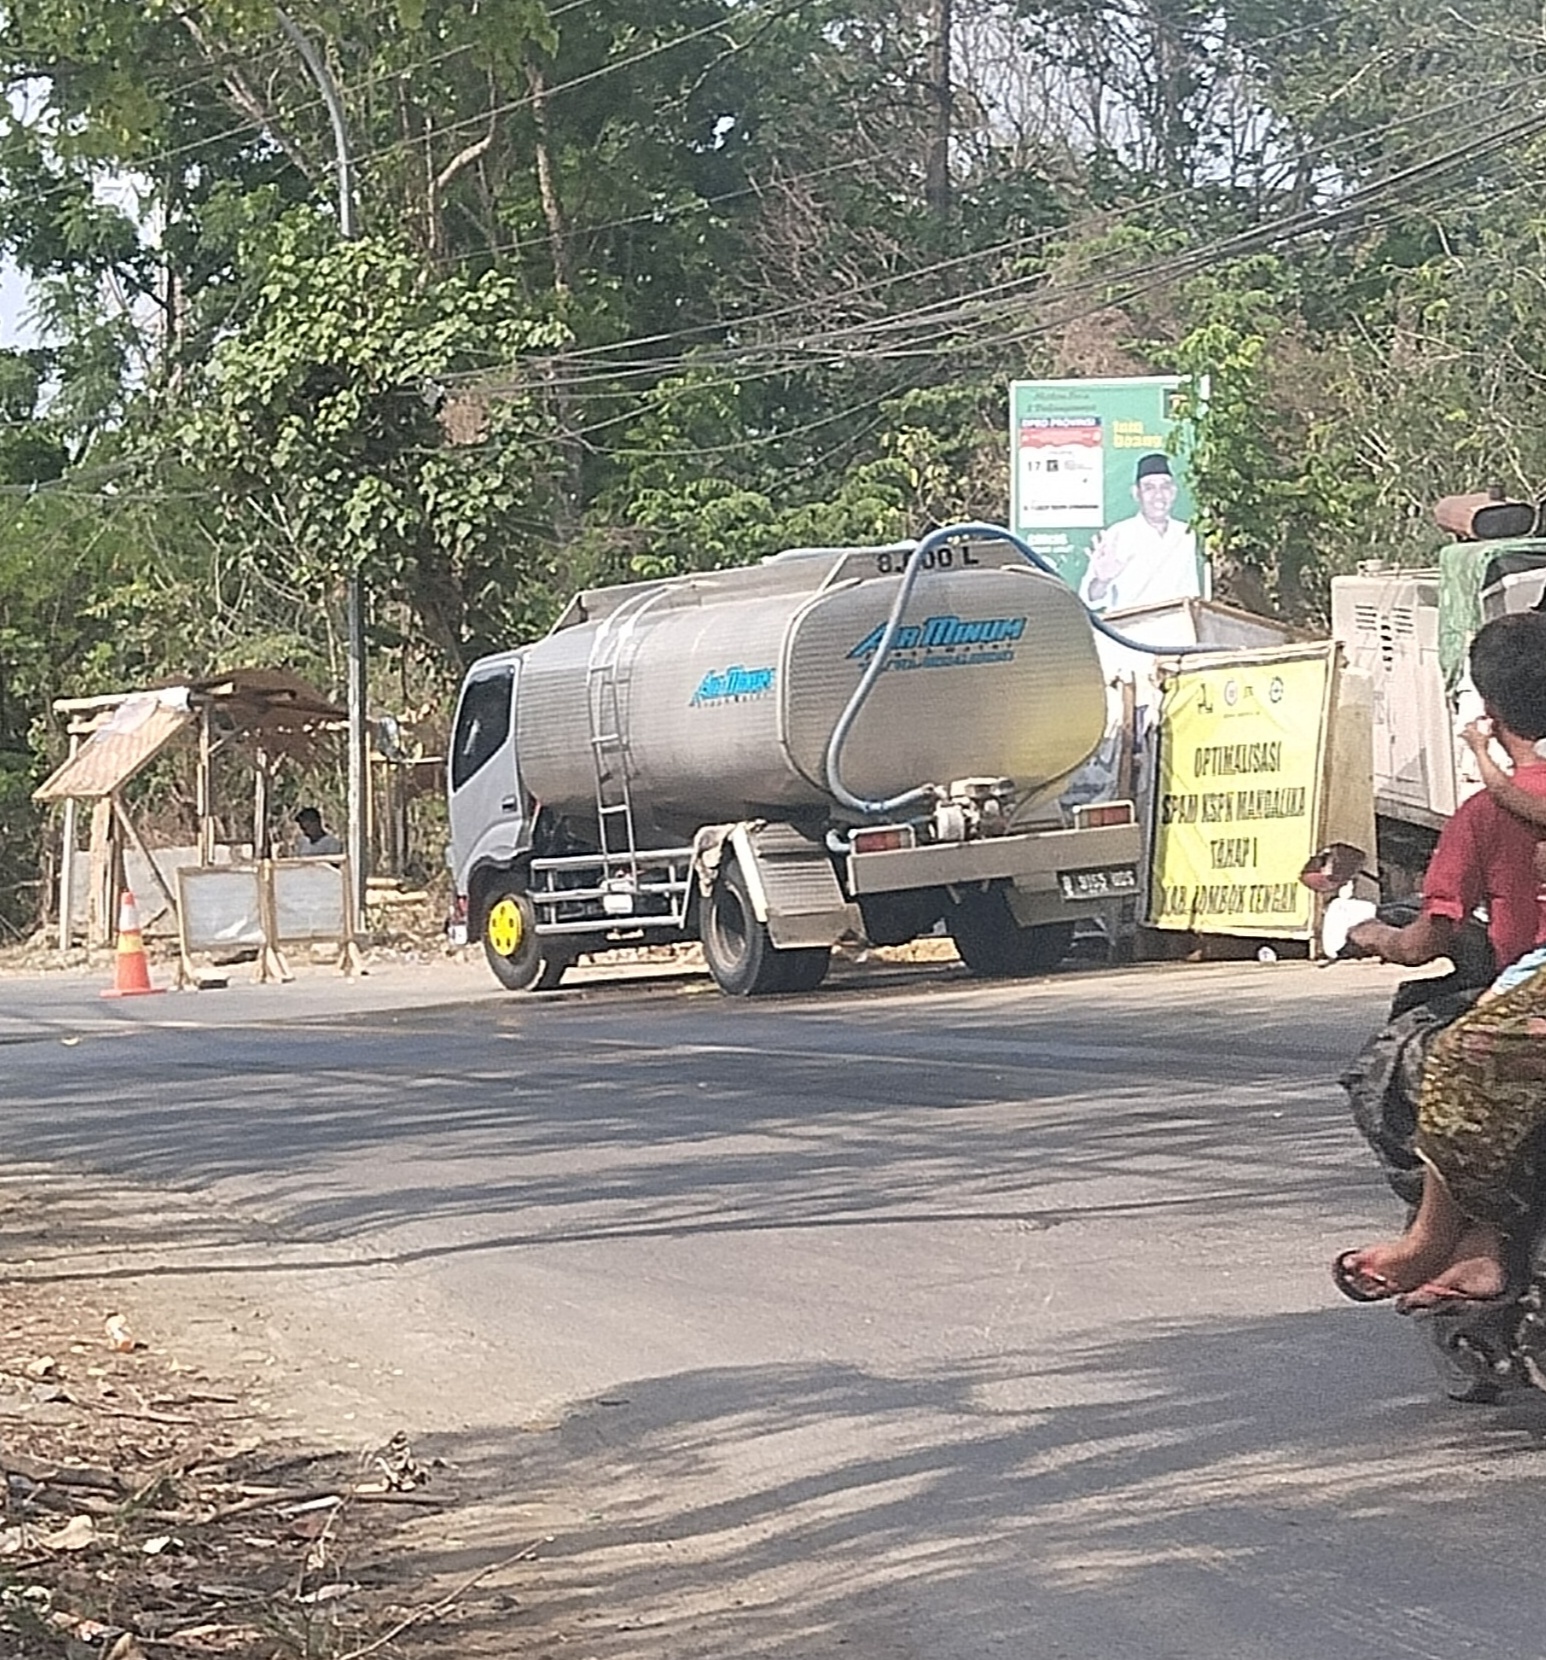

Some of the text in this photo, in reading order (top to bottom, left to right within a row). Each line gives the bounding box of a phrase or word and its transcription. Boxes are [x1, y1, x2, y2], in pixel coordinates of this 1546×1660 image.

[962, 545, 980, 565] L
[1194, 741, 1282, 778] OPTIMALISASI
[1162, 794, 1198, 824] SPAM
[1236, 786, 1306, 822] MANDALIKA
[1210, 836, 1250, 869] TAHAP
[1249, 881, 1299, 914] TENGAH
